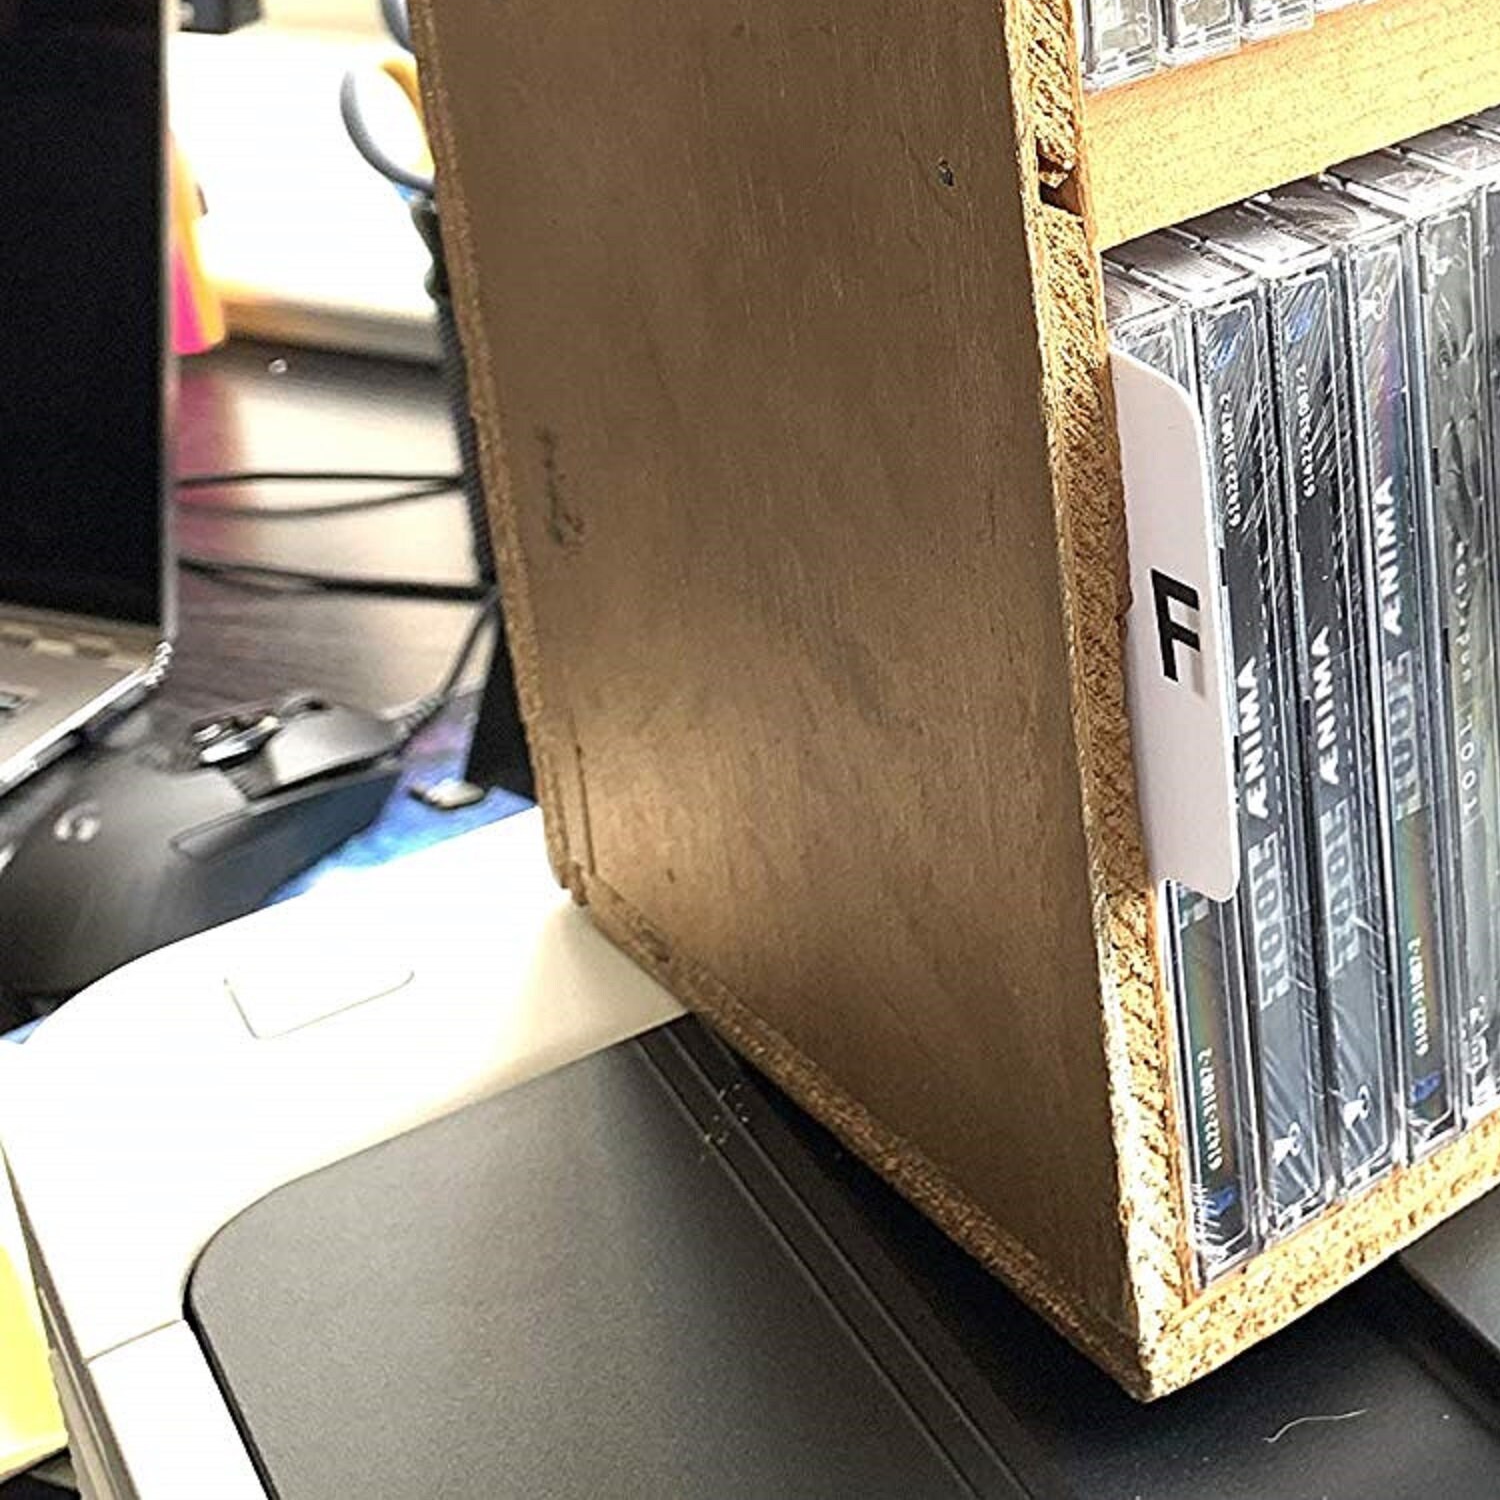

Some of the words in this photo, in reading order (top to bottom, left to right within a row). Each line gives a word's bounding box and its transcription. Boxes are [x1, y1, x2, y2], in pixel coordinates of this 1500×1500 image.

[1152, 568, 1200, 681] F
[1461, 715, 1477, 813] TOOL
[1251, 836, 1290, 1007] TOOL
